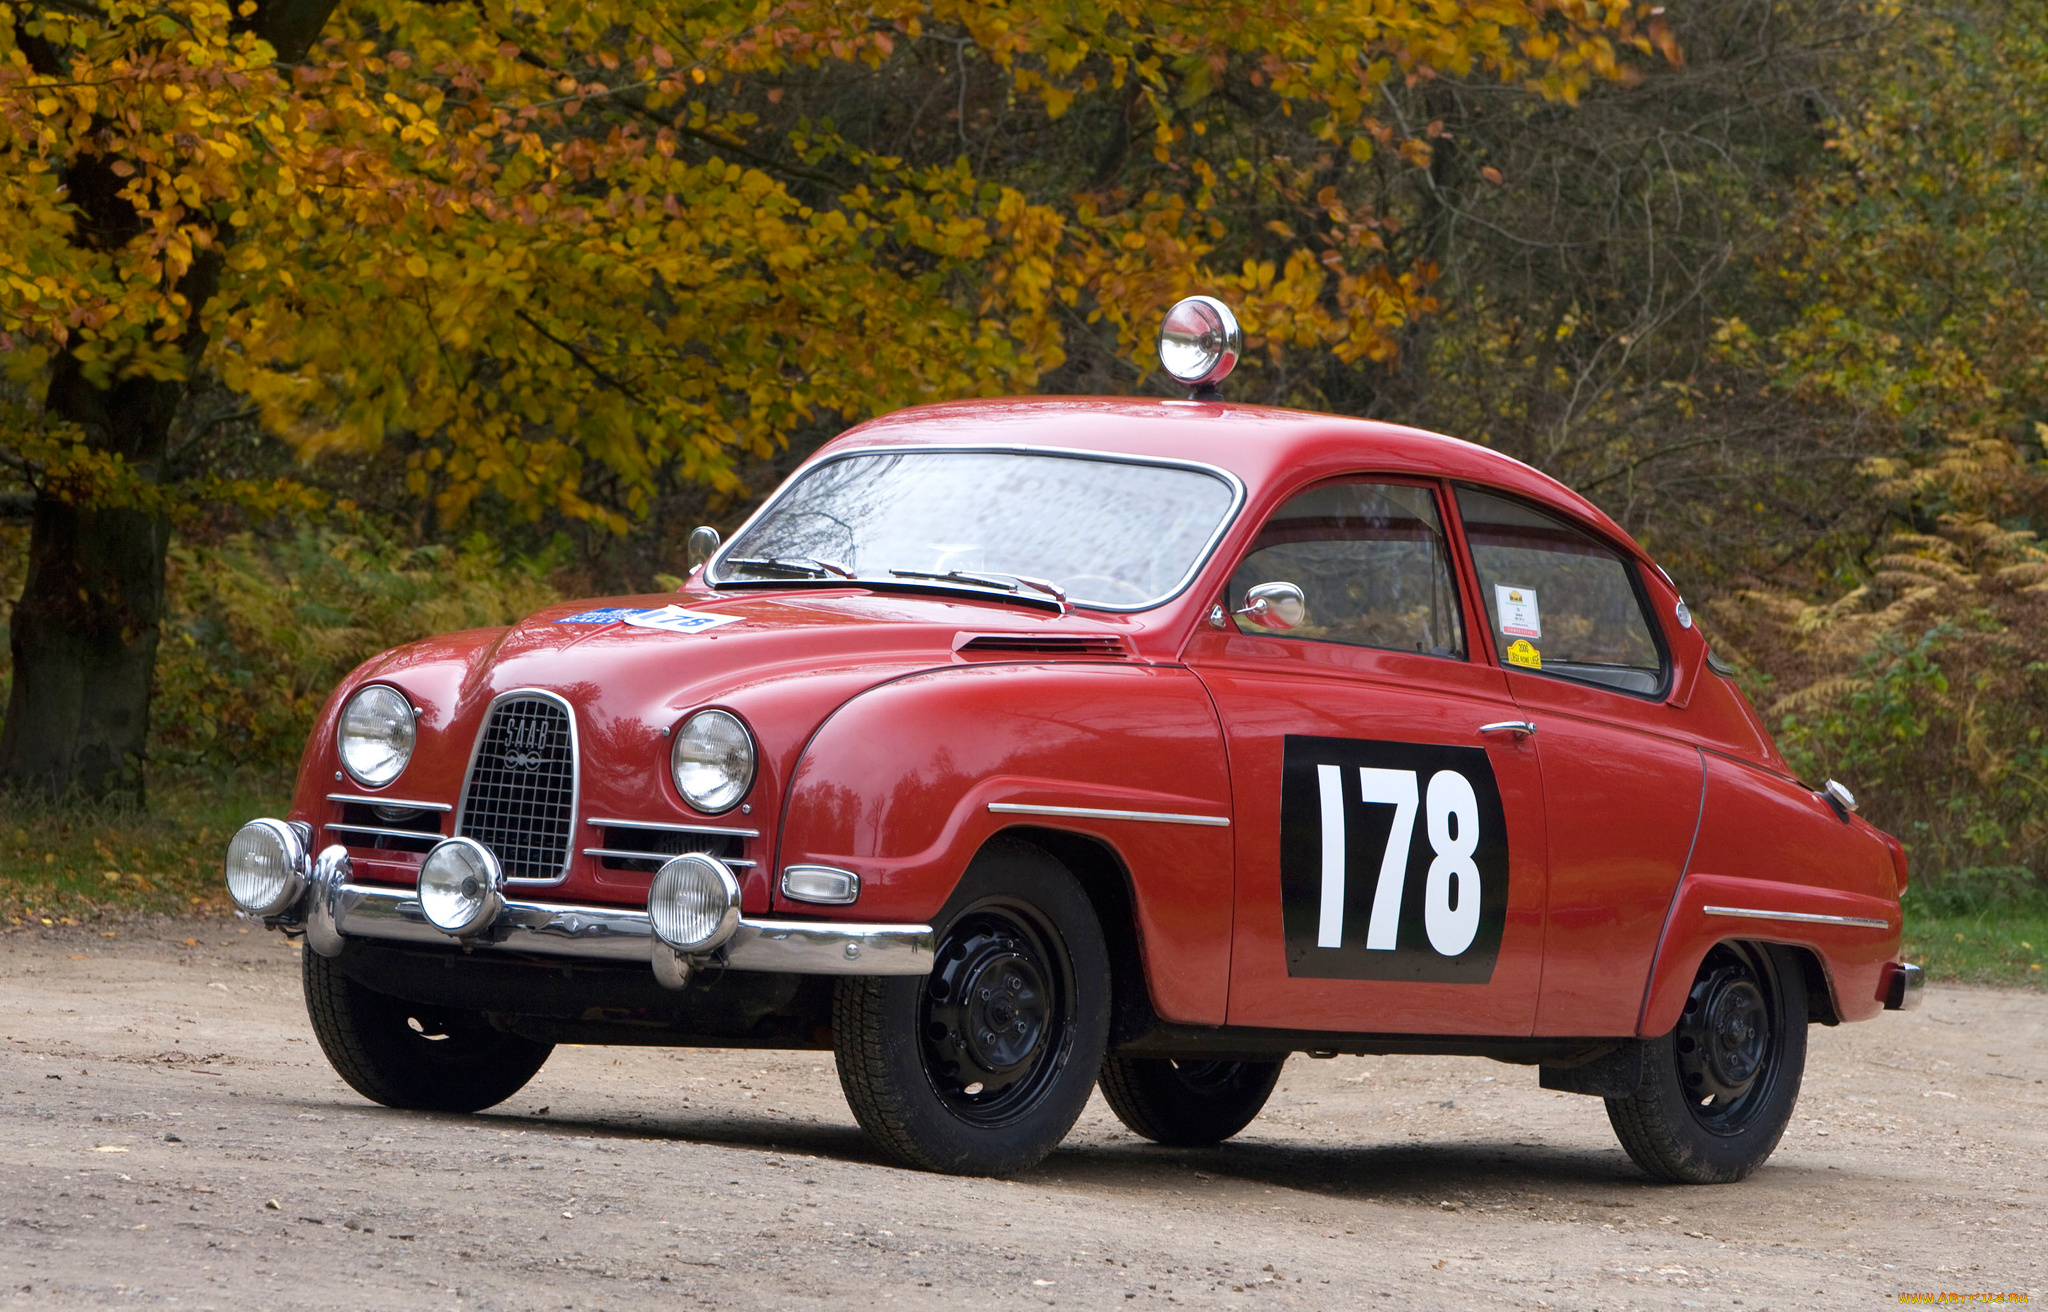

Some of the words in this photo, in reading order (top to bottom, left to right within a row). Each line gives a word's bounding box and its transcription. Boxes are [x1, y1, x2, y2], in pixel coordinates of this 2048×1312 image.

[639, 611, 715, 627] 178
[504, 718, 549, 750] SAAB
[1317, 764, 1481, 956] 178
